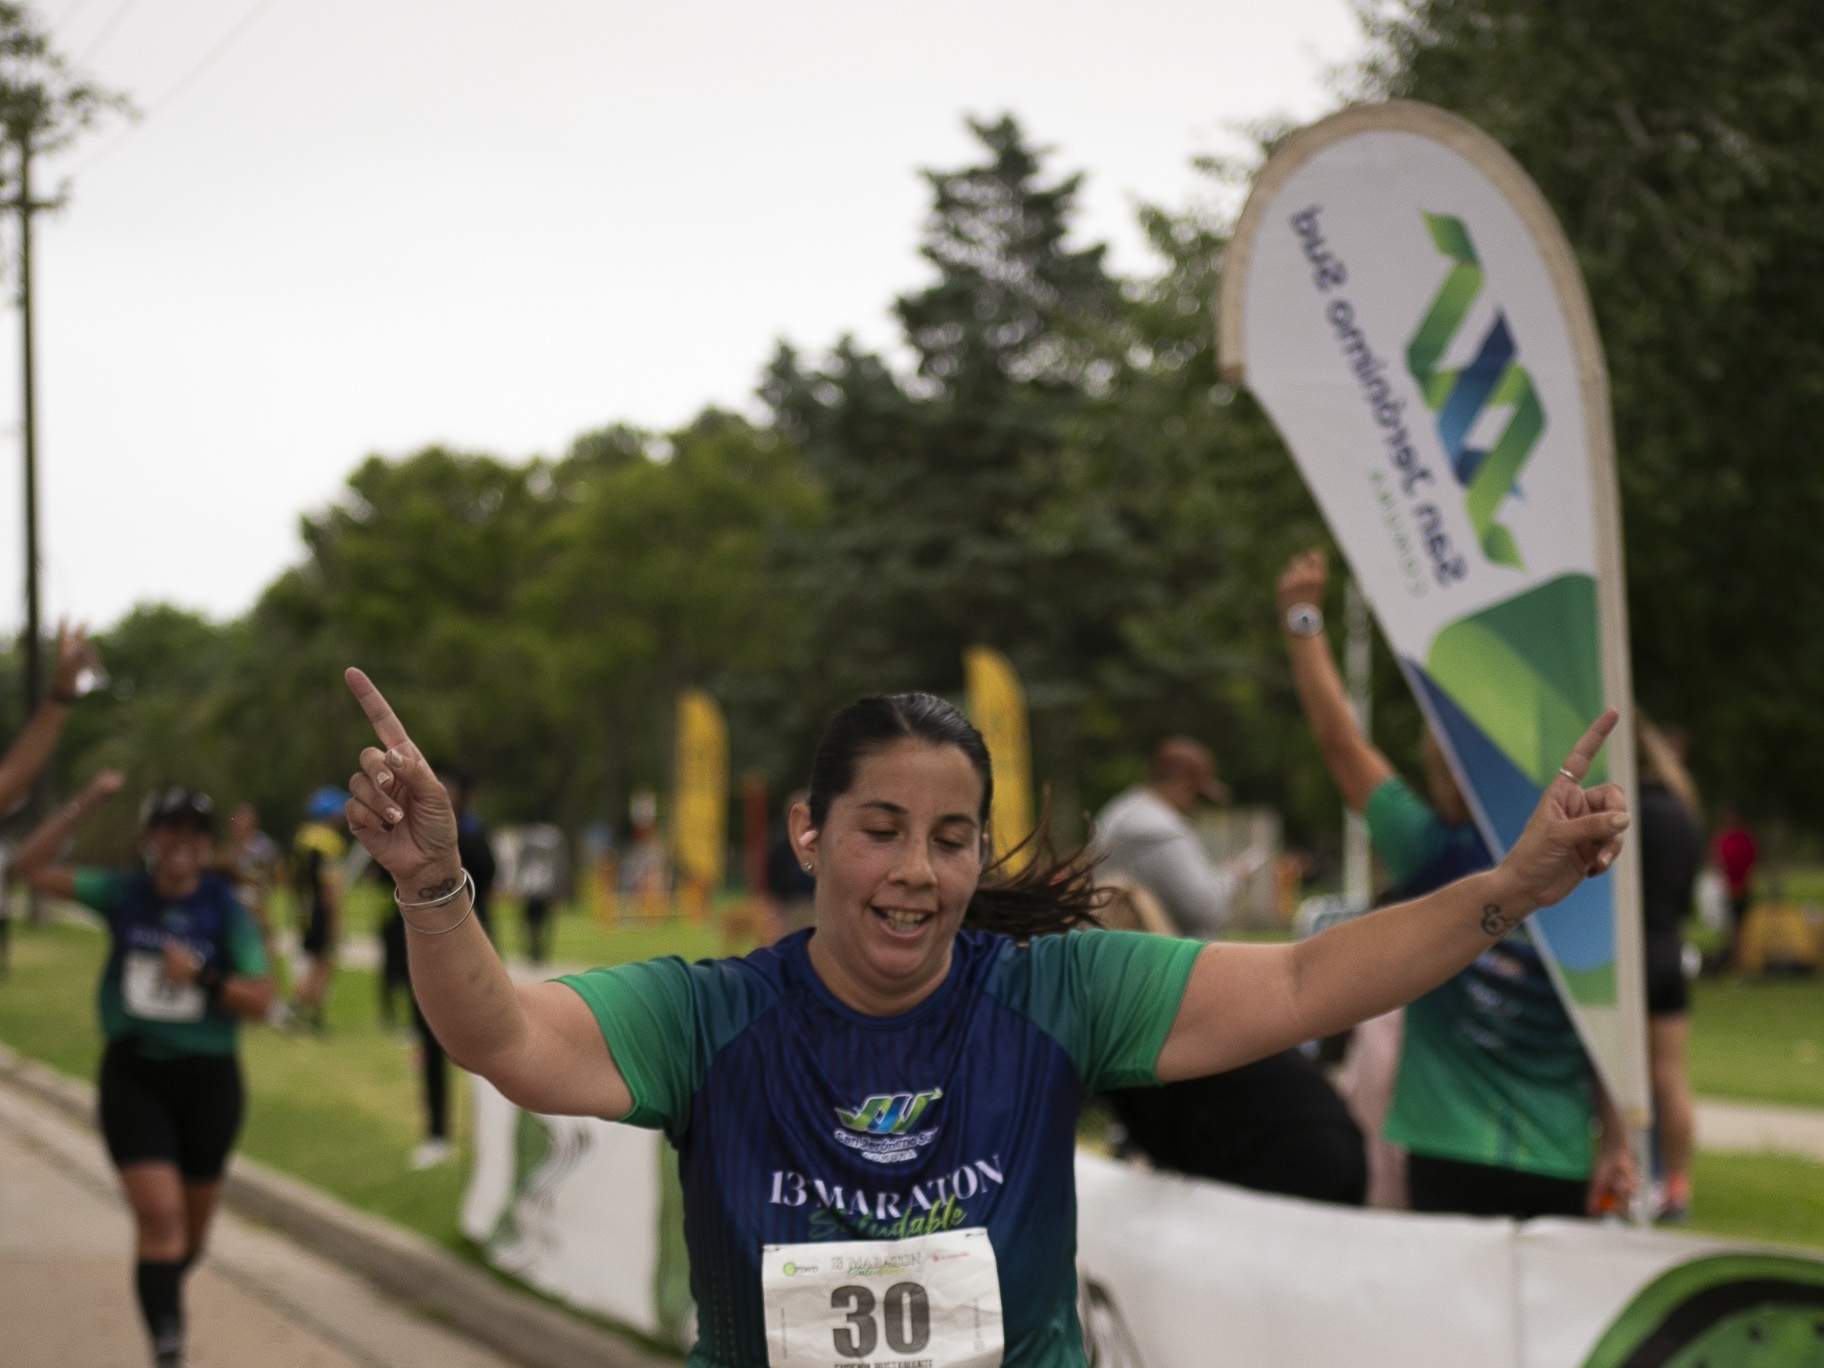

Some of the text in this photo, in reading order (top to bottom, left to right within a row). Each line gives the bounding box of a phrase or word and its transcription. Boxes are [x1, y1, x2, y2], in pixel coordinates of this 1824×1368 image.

[769, 1153, 1004, 1219] 13 MARATON
[831, 1281, 930, 1358] 30
